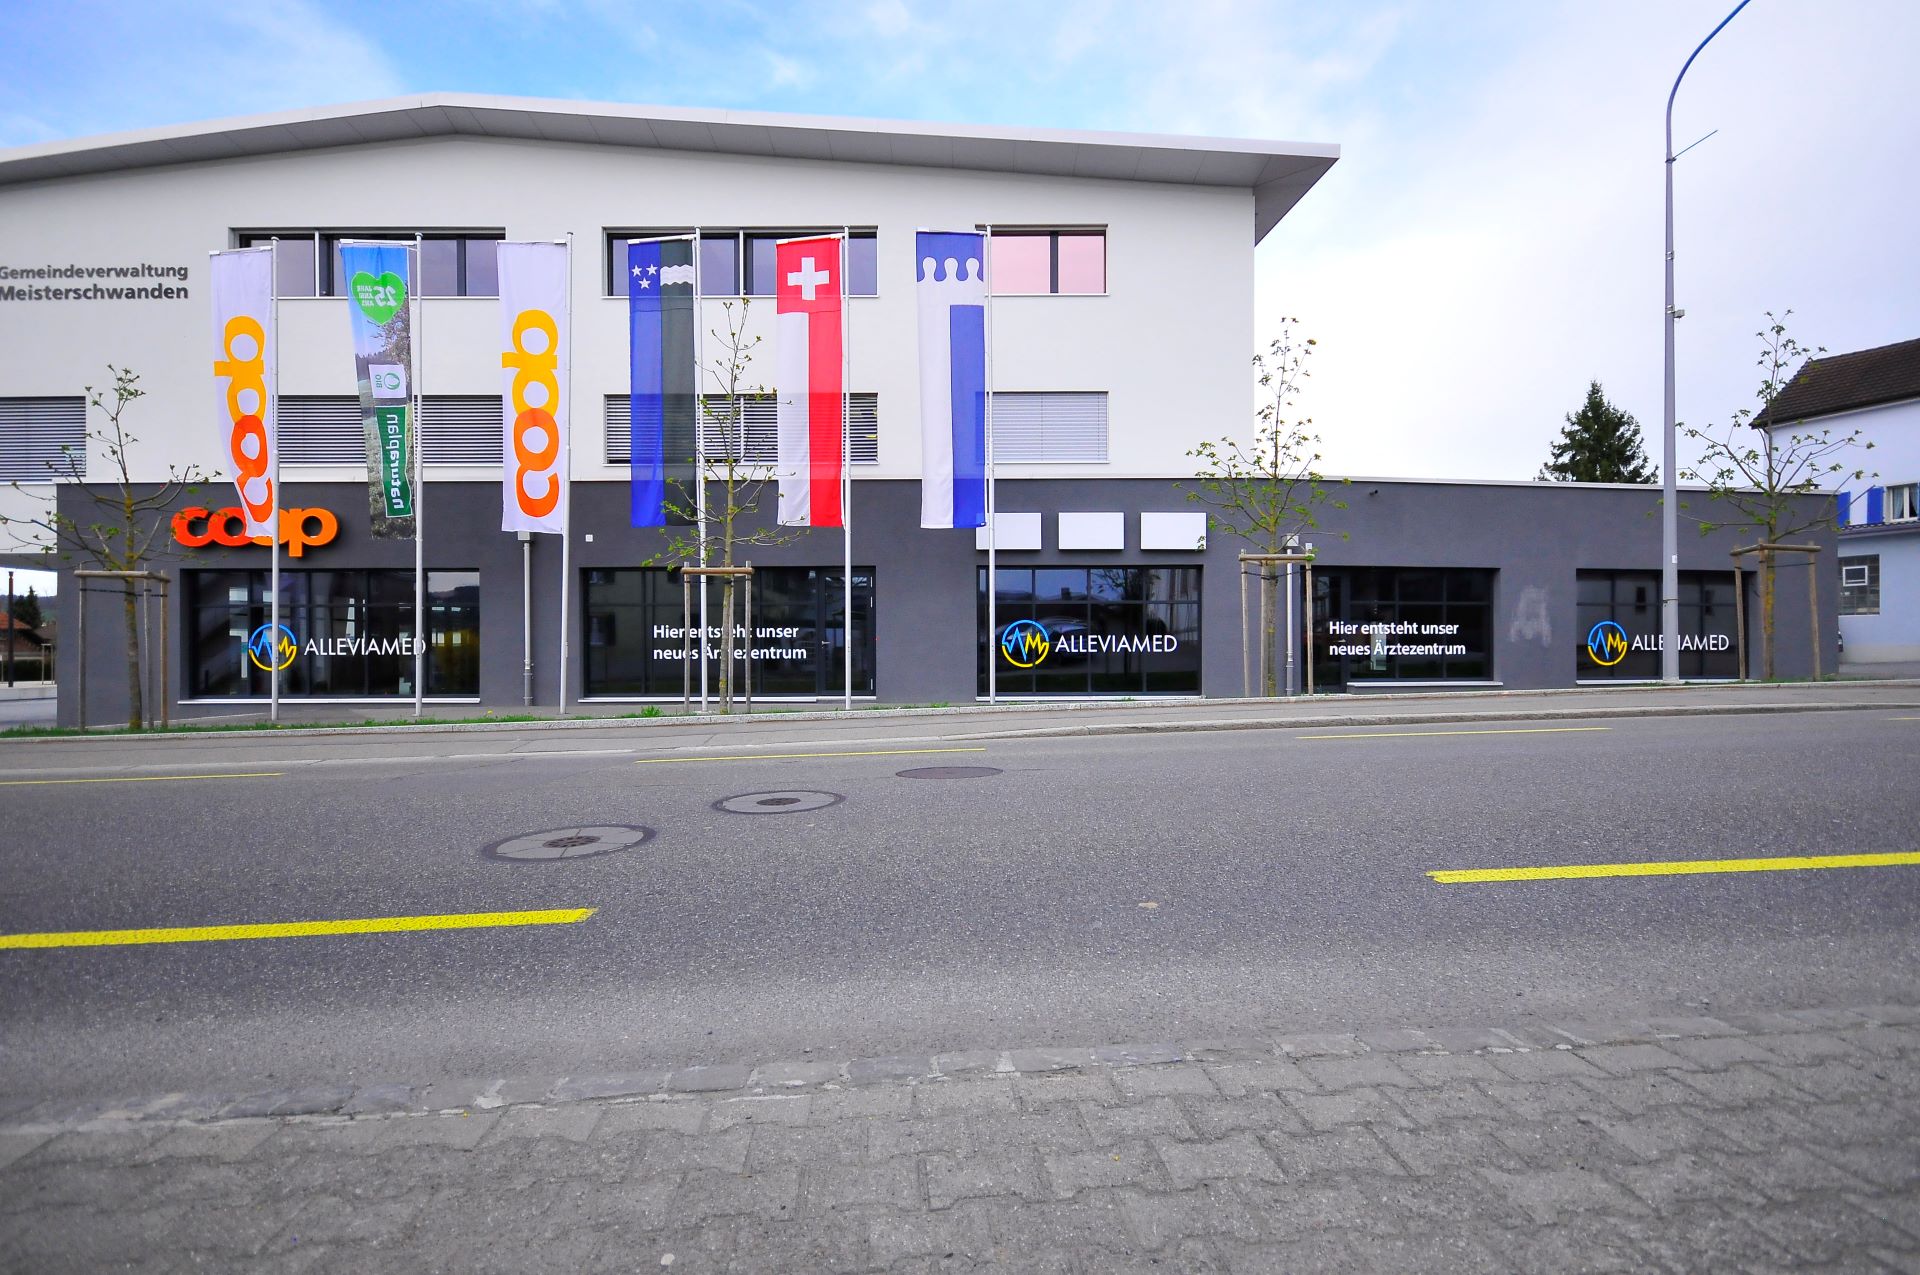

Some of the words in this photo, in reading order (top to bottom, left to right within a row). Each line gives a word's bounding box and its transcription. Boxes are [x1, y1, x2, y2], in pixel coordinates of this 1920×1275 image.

[0, 264, 188, 280] Gemeindeverwaltung
[0, 283, 188, 301] Meisterschwanden
[170, 506, 340, 557] cop
[756, 626, 799, 638] unser
[1329, 621, 1358, 635] Hier
[1361, 621, 1418, 635] entsteht
[1421, 623, 1459, 635] unser
[304, 638, 426, 656] ALLEVIAMED
[1055, 634, 1178, 653] ALLEVIAMED
[1329, 644, 1370, 656] neues
[1374, 639, 1466, 656] Ärztezentrum
[1631, 634, 1730, 651] ALLEIAMED
[705, 643, 807, 660] Ärezentrum
